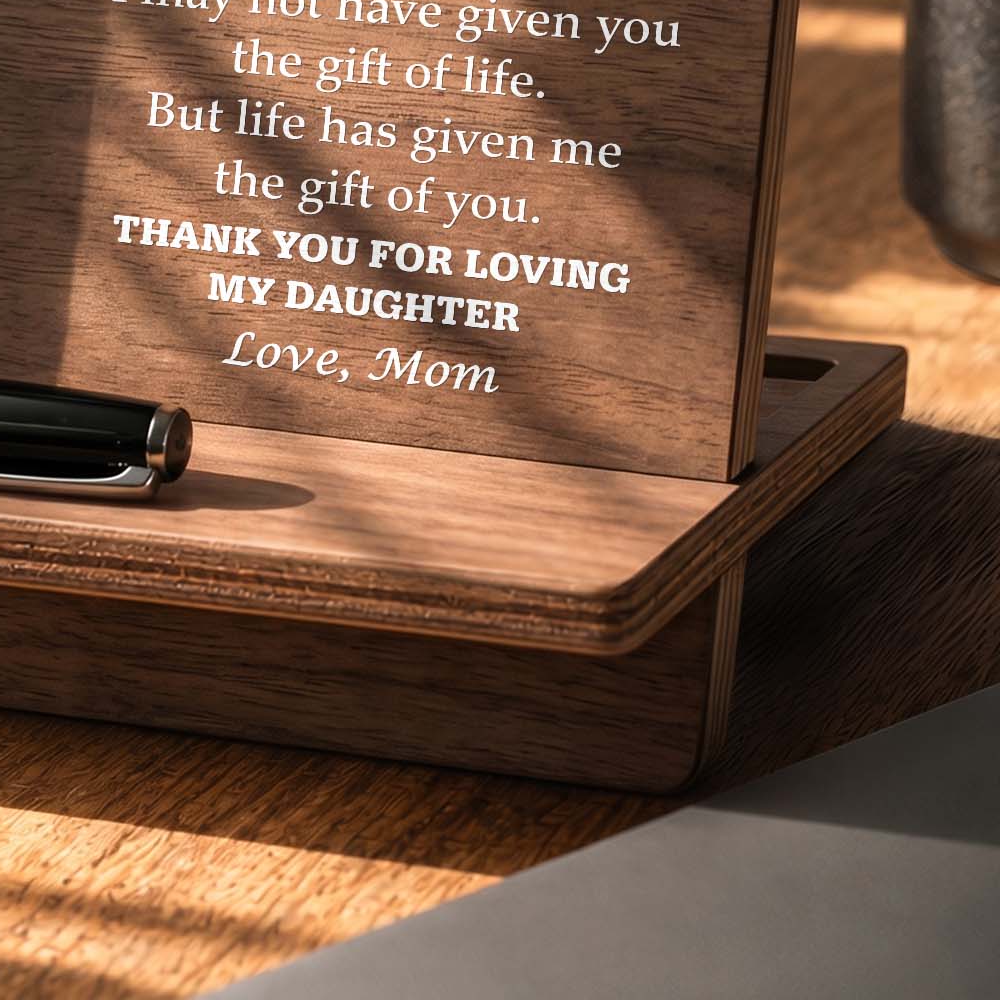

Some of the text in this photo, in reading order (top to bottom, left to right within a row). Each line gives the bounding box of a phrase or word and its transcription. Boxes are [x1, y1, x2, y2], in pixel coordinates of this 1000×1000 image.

[594, 16, 681, 55] you
[231, 37, 547, 100] the gift of life.
[146, 90, 623, 170] But life has given me
[213, 159, 541, 229] the gift of you.
[113, 213, 631, 295] THANK YOU FOR LOVING
[207, 272, 520, 332] MY DAUGHTER
[221, 331, 499, 393] Love, Mom
